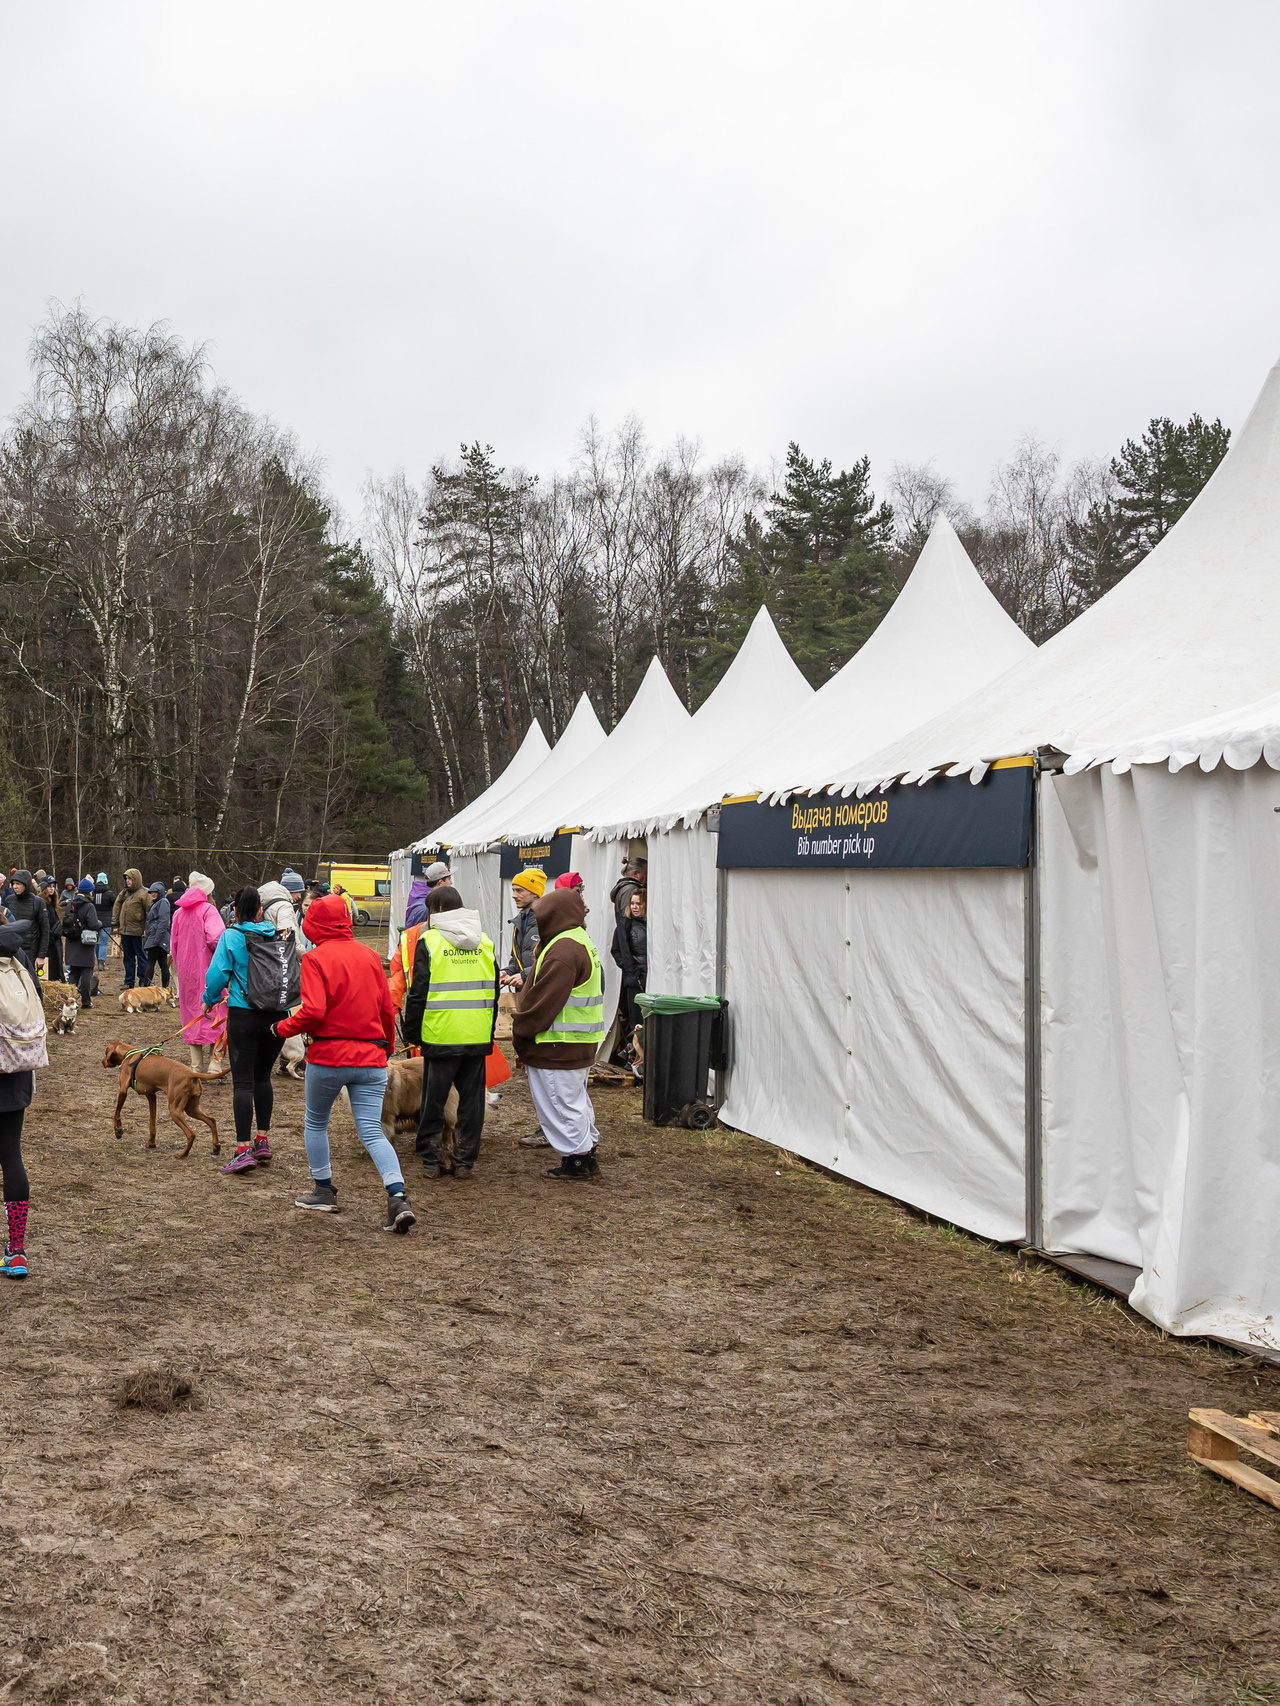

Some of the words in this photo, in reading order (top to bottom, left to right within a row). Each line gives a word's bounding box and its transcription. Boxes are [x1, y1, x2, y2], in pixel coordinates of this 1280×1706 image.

[792, 804, 831, 834] Выдача
[834, 800, 888, 832] номеров
[797, 836, 810, 855] Bib
[811, 834, 842, 854] number
[842, 832, 861, 859] pick
[862, 836, 875, 858] up
